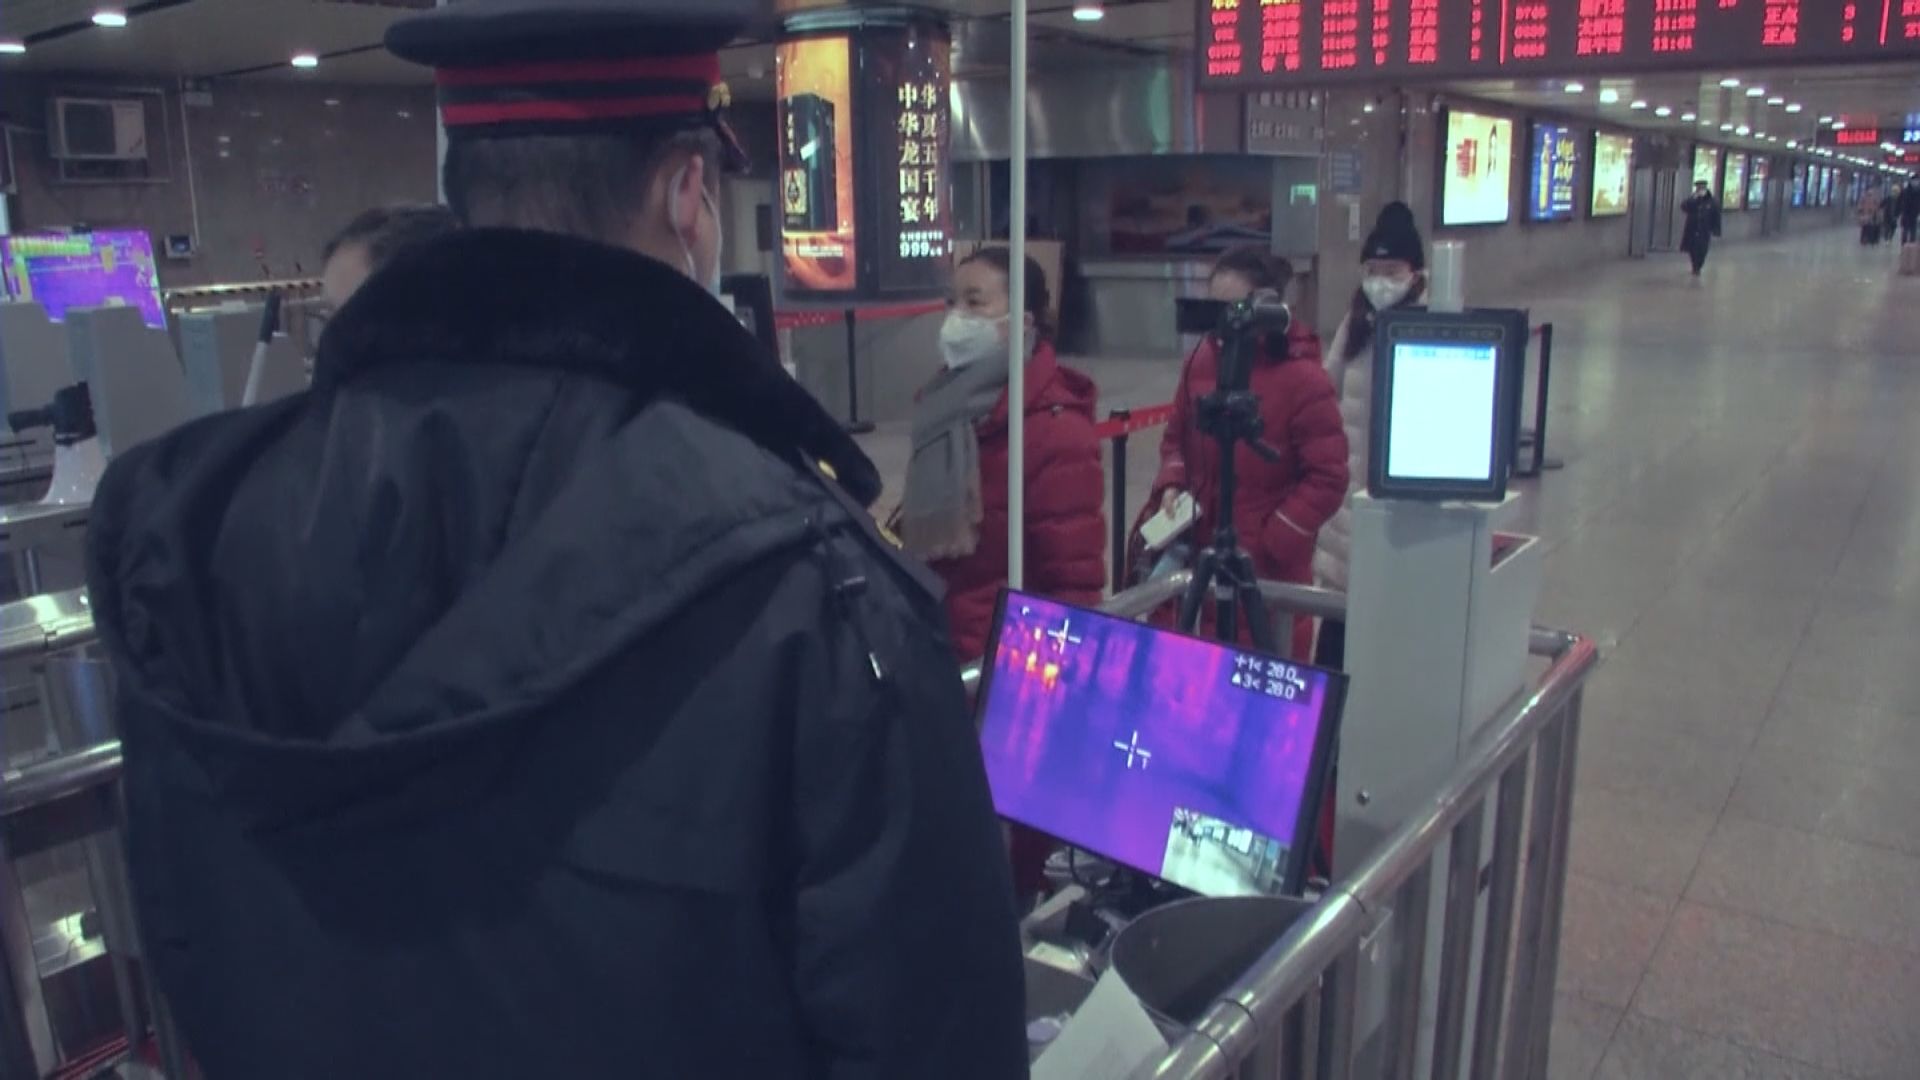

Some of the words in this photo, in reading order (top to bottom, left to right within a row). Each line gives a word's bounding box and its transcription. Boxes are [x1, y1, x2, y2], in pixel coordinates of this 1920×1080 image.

[899, 82, 920, 223] 中华龙国宴
[921, 82, 939, 222] 华夏五千年
